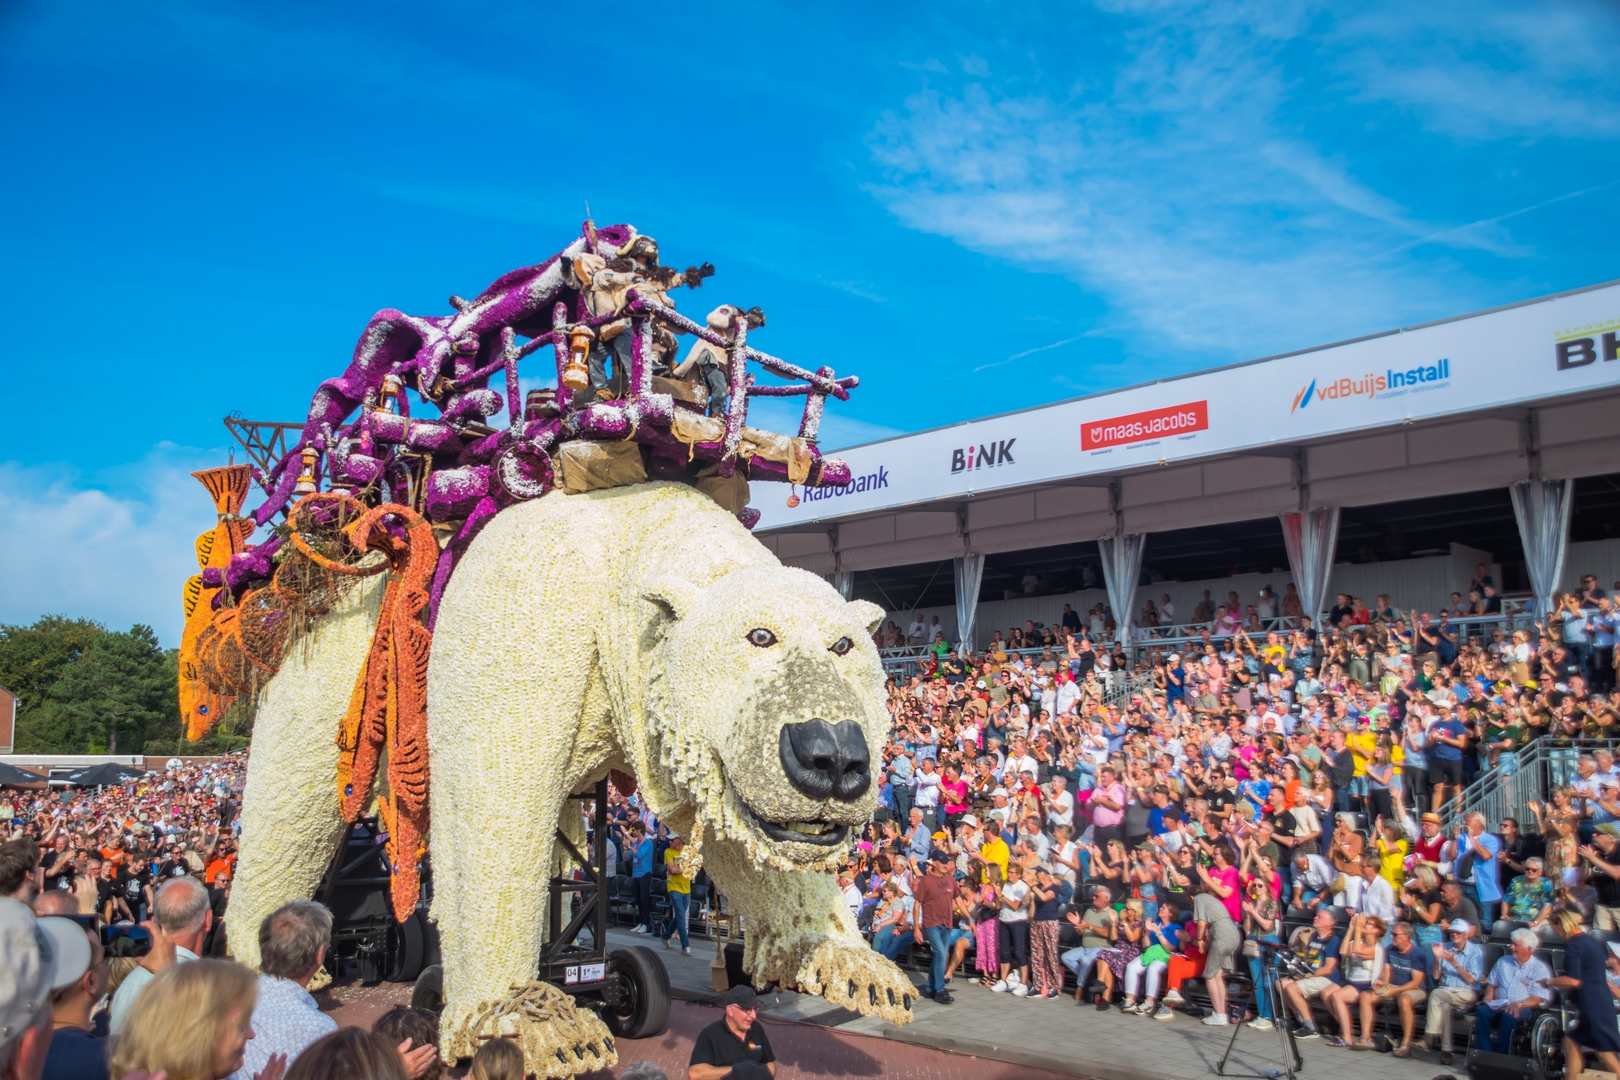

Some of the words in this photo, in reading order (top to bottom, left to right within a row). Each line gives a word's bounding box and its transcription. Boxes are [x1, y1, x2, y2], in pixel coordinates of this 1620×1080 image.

[1316, 358, 1449, 400] vdBuijsInstall
[1376, 388, 1408, 400] installeert
[1410, 381, 1450, 394] vertrouwen
[567, 968, 577, 977] 04
